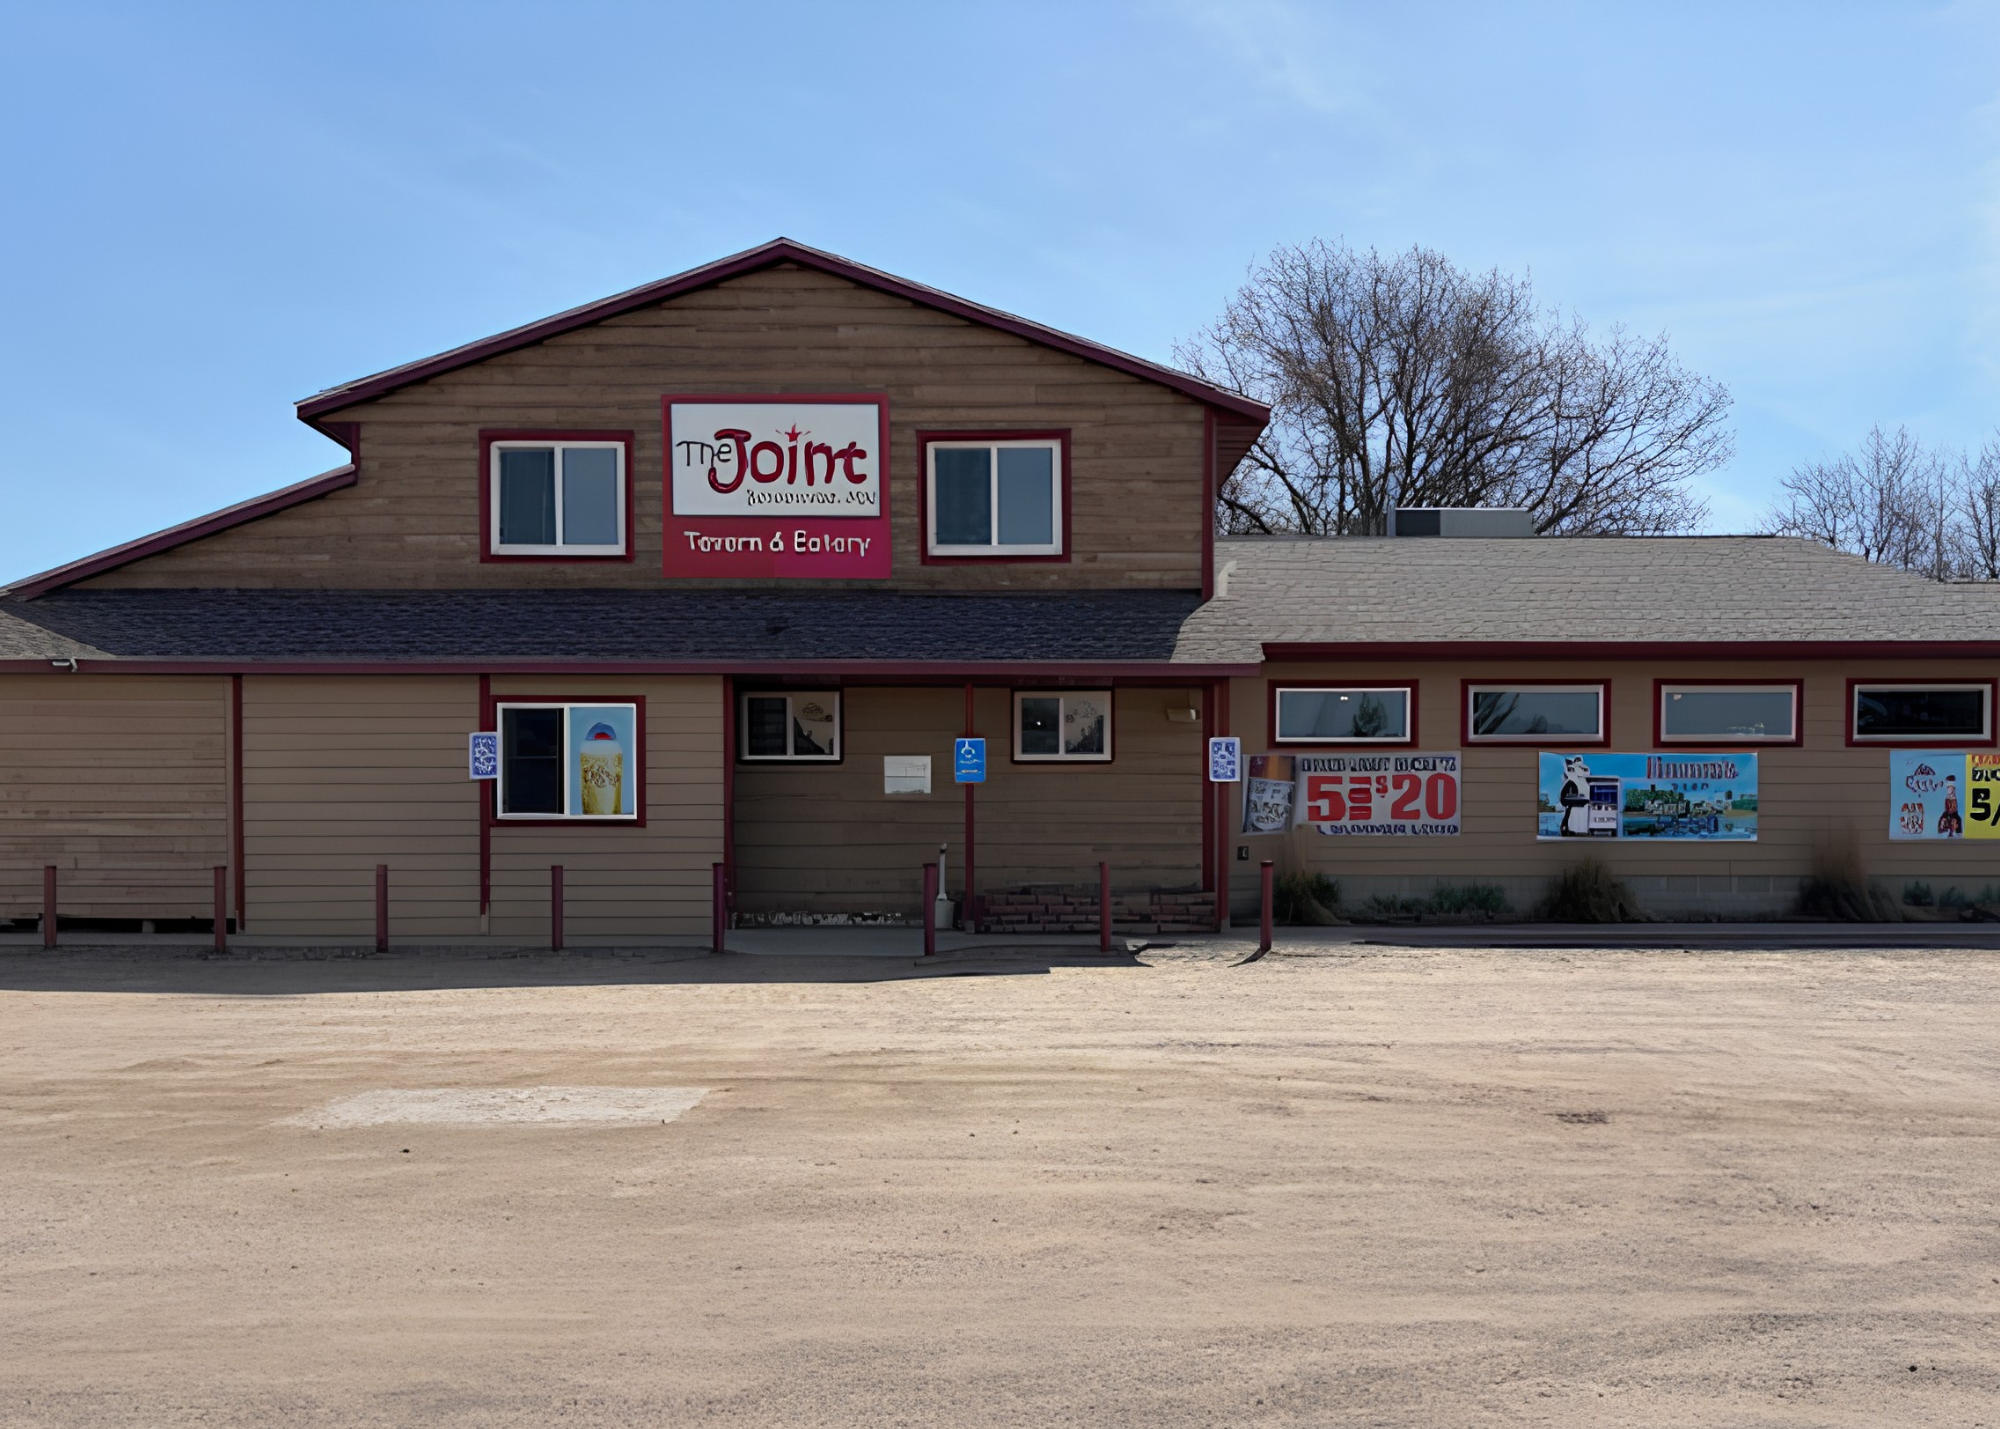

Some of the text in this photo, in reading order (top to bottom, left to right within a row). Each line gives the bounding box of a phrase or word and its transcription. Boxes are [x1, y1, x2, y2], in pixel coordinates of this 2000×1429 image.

[676, 424, 867, 493] The Joint
[1307, 775, 1347, 821] 5
